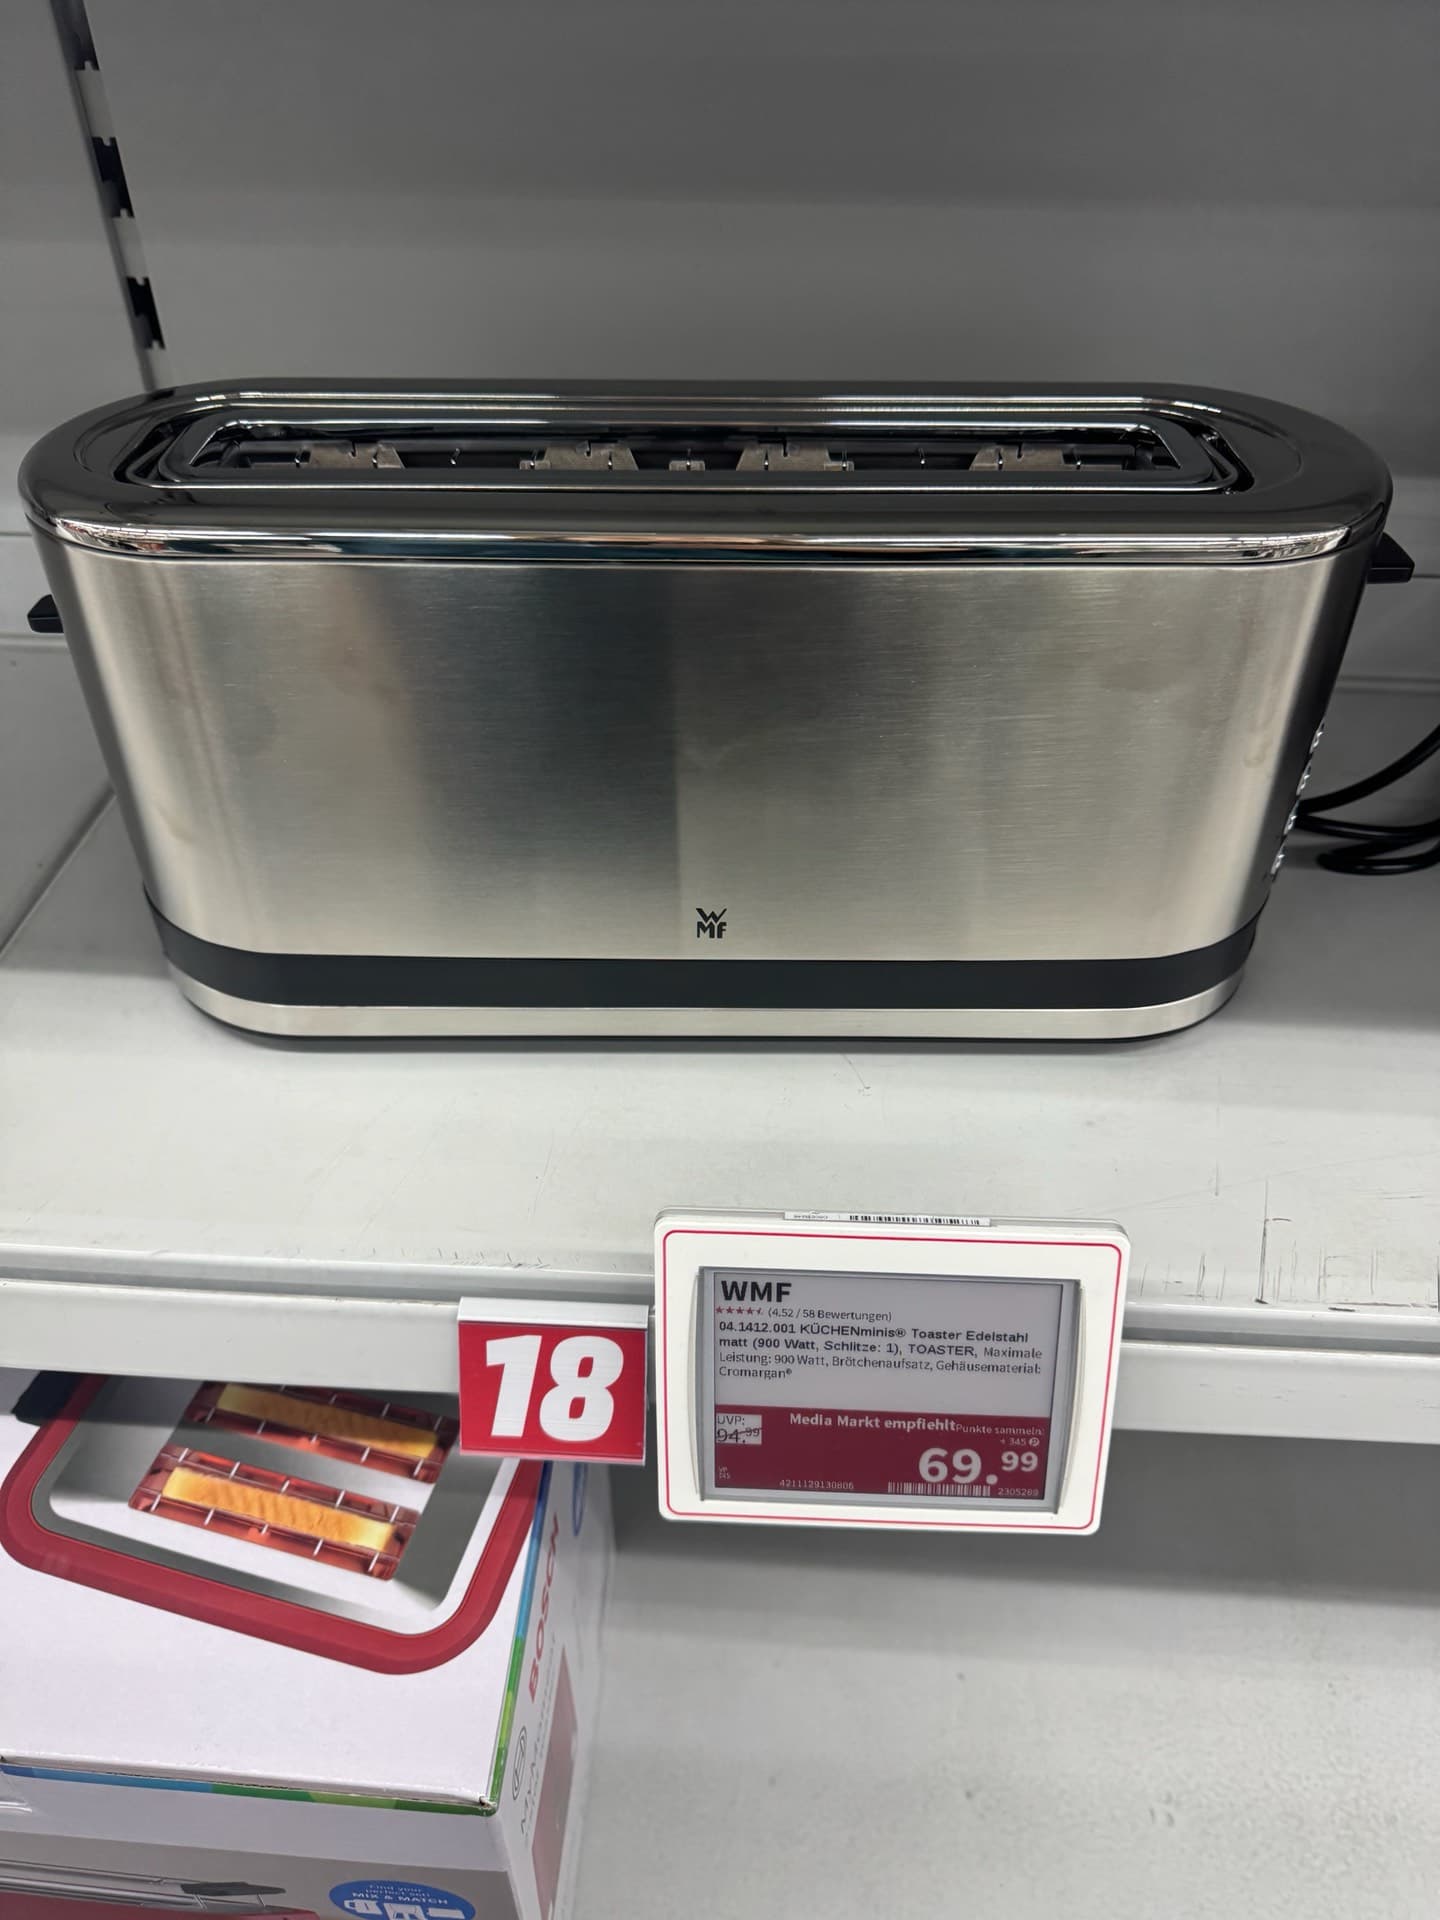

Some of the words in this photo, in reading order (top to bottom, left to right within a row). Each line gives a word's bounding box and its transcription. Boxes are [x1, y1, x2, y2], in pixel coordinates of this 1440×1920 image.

[696, 908, 727, 939] WMF
[721, 1280, 792, 1302] WMF
[768, 1307, 793, 1319] (4.52
[803, 1309, 815, 1319] 58
[817, 1310, 892, 1323] Bewertungen)
[719, 1321, 796, 1333] 04.1412.001
[912, 1328, 962, 1340] Toaster
[966, 1330, 1028, 1342] Edelstahl
[719, 1338, 747, 1347] matt
[752, 1337, 780, 1349] (900
[784, 1338, 819, 1350] Watt,
[824, 1340, 881, 1352] Schlitze:
[886, 1343, 902, 1355] 1),
[908, 1343, 978, 1358] TOASTER,
[984, 1347, 1043, 1359] Maximale
[719, 1351, 772, 1365] Leistung:
[774, 1354, 795, 1364] 900
[796, 1355, 829, 1367] Watt,
[832, 1356, 933, 1372] Brötchenaufsatz,
[936, 1360, 1041, 1374] Gehäusematerial:
[486, 1335, 624, 1442] 18
[717, 1415, 745, 1426] UVP:
[790, 1413, 832, 1426] Media
[837, 1415, 880, 1428] Markt
[884, 1417, 956, 1432] empfiehlt
[956, 1424, 992, 1434] Punkte
[994, 1426, 1045, 1436] sammeln:
[779, 1479, 855, 1490] 4211129130806
[529, 1512, 559, 1704] BOSCH
